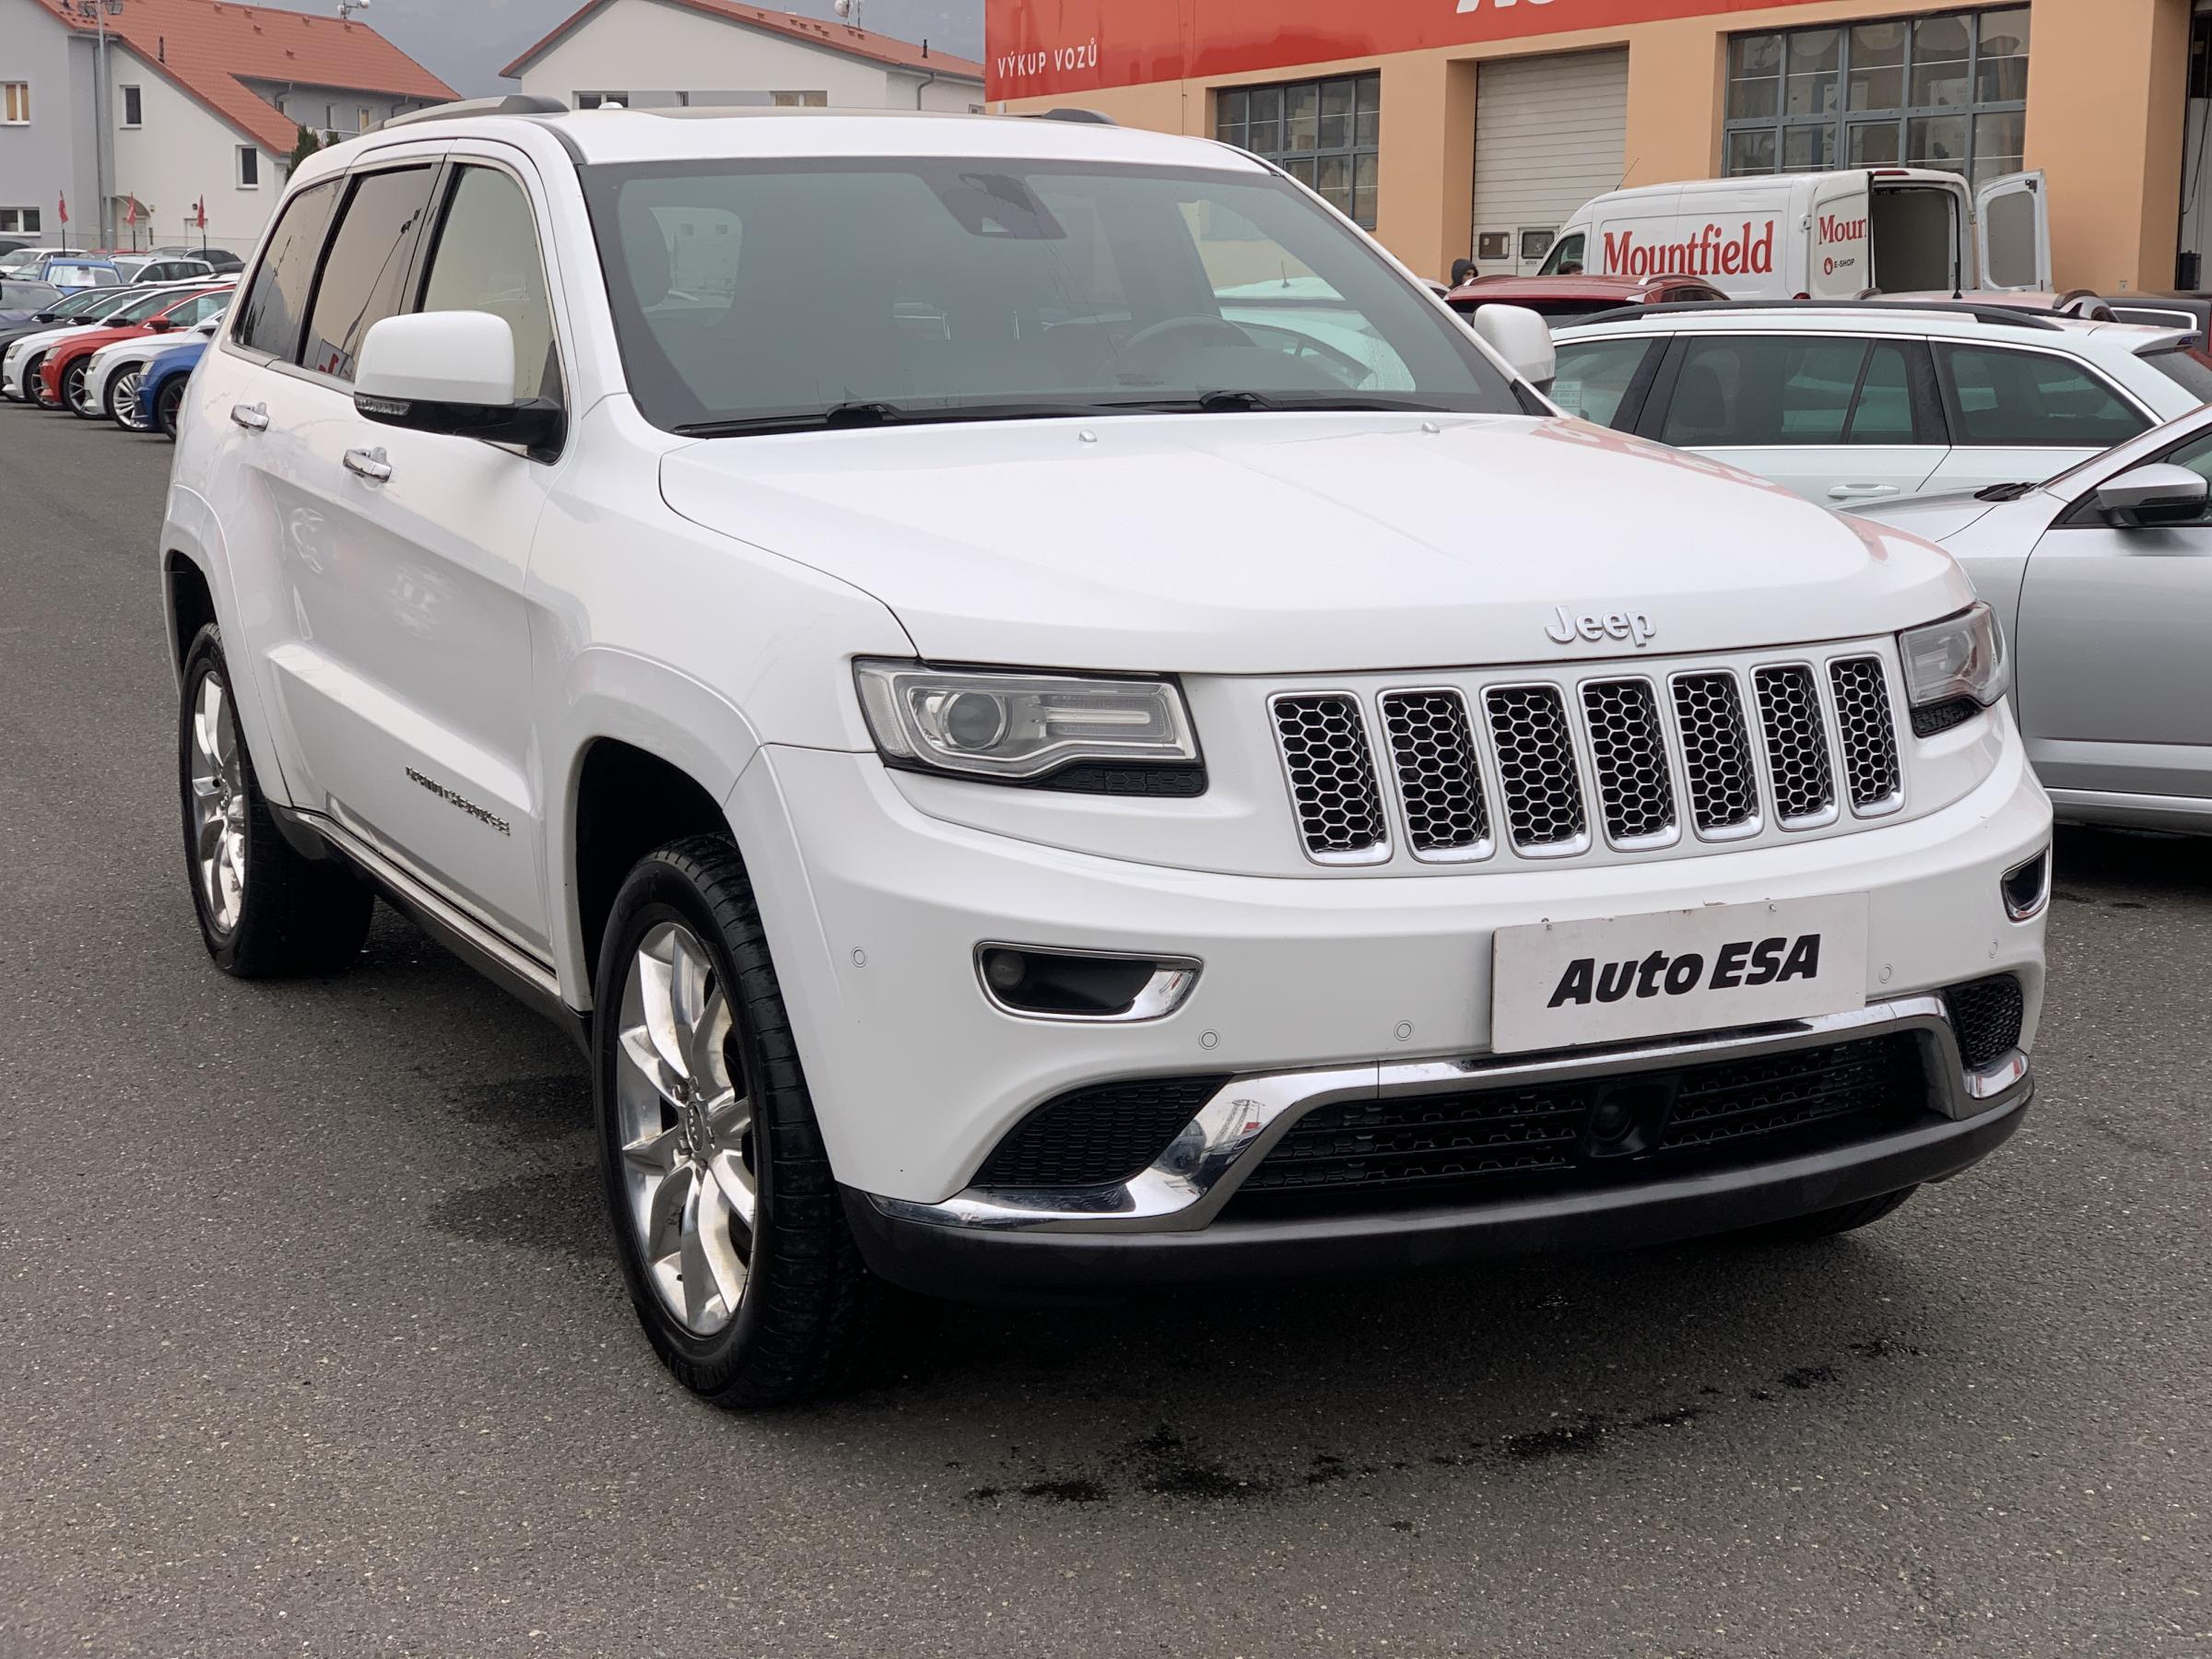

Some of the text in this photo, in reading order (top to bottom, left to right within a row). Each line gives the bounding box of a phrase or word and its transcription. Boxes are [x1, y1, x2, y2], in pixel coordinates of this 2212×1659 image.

[997, 37, 1098, 79] VÝKUP VOZŮ
[1604, 219, 1775, 276] Mountfield
[1833, 258, 1856, 268] E-SHOP
[1545, 605, 1657, 647] Jeep
[1547, 934, 1822, 1008] Auto ESA
